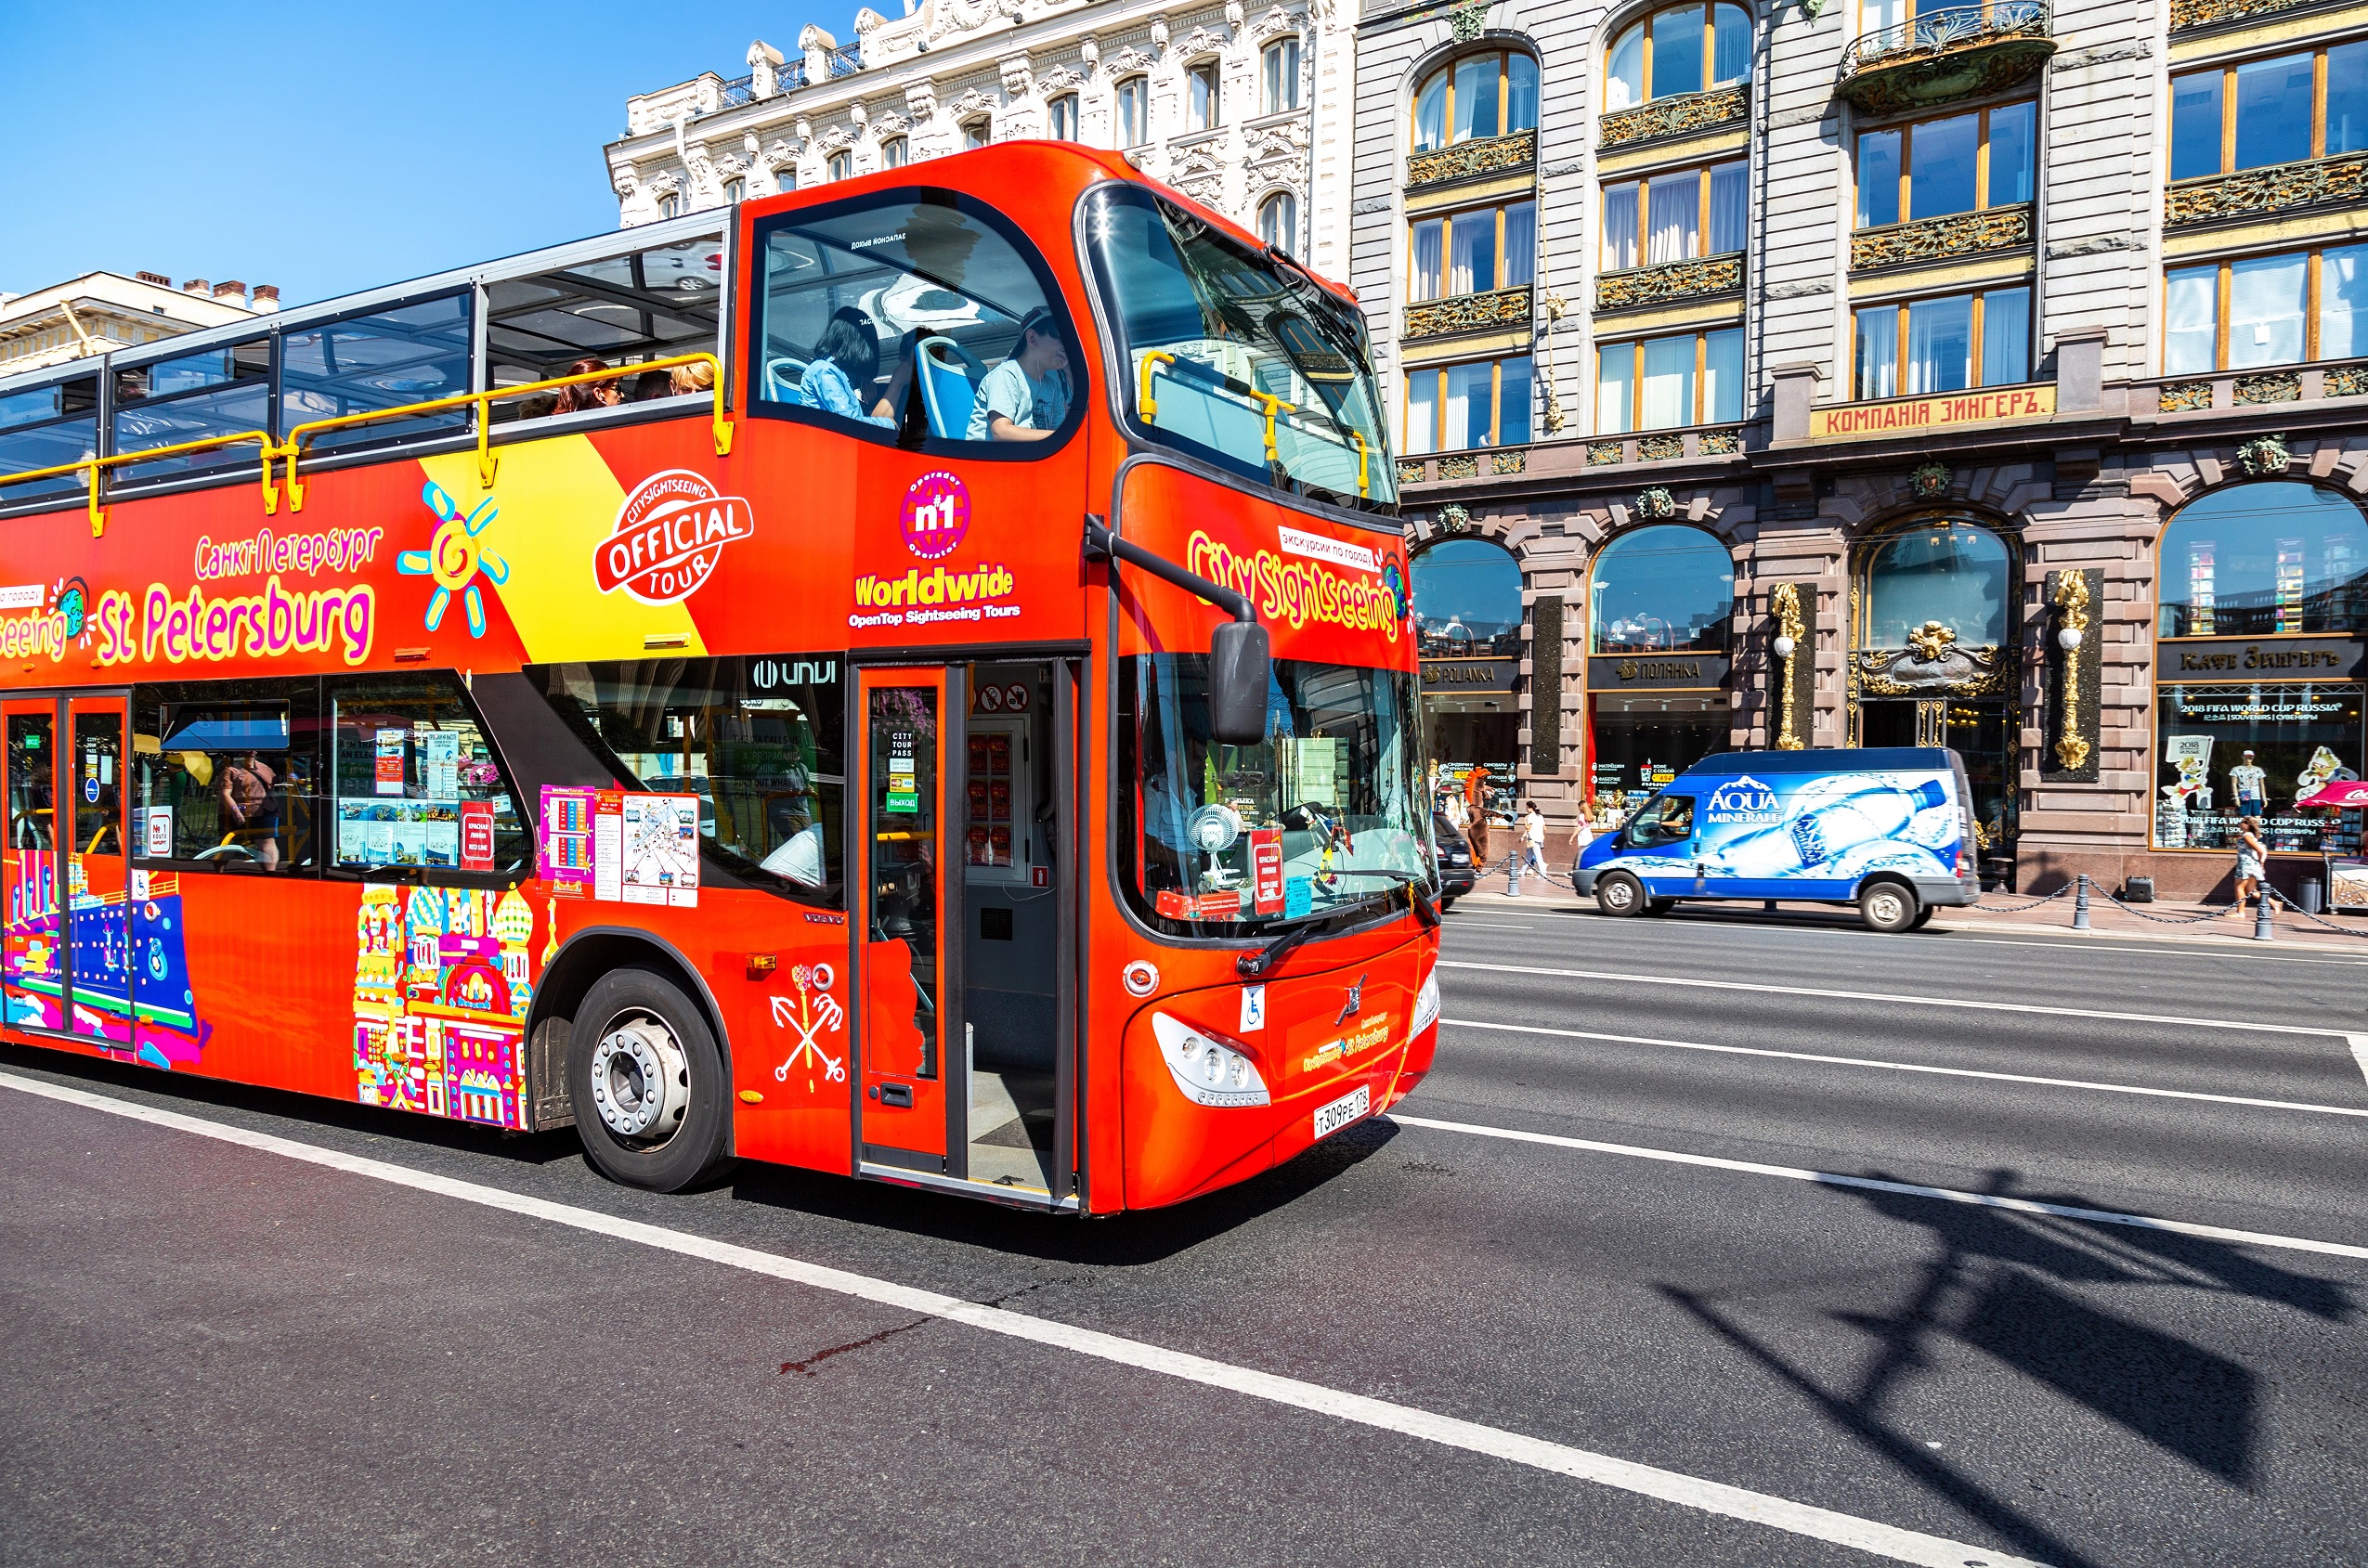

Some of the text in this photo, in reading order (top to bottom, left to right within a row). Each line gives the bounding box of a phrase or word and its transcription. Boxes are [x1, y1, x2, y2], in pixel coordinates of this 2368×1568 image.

[910, 472, 961, 492] Operador
[627, 479, 708, 524] CITYSIGHTSEEING
[609, 503, 743, 578] OFFICIAL
[1282, 533, 1372, 566] экскурсии по городу
[195, 527, 384, 580] Санкт-Петербург
[908, 541, 957, 560] Operator
[650, 554, 709, 594] TOUR
[855, 564, 1013, 606] Worldwide
[8, 590, 40, 603] городу
[98, 590, 137, 667] St
[142, 575, 375, 667] Petersburg
[849, 604, 1021, 628] OpenTop Sightseeing Tours
[1442, 667, 1494, 683] POLIANKA
[1640, 661, 1700, 680] ПОЛЯНКА
[2180, 705, 2205, 713] 2018
[2206, 705, 2229, 713] FIFA
[2271, 704, 2296, 712] CUP
[764, 734, 787, 744] CALLS
[890, 798, 916, 808] ВЫХОД
[1705, 790, 1782, 813] AQUA
[468, 823, 488, 831] КРАСНАЯ
[1707, 812, 1782, 823] MINERALE
[2205, 817, 2228, 825] FIFA
[2269, 818, 2292, 826] CUP
[2274, 827, 2317, 836] СУВЕНИРЫ
[803, 913, 844, 925] VOLVO
[1354, 1026, 1389, 1055] Petersburg
